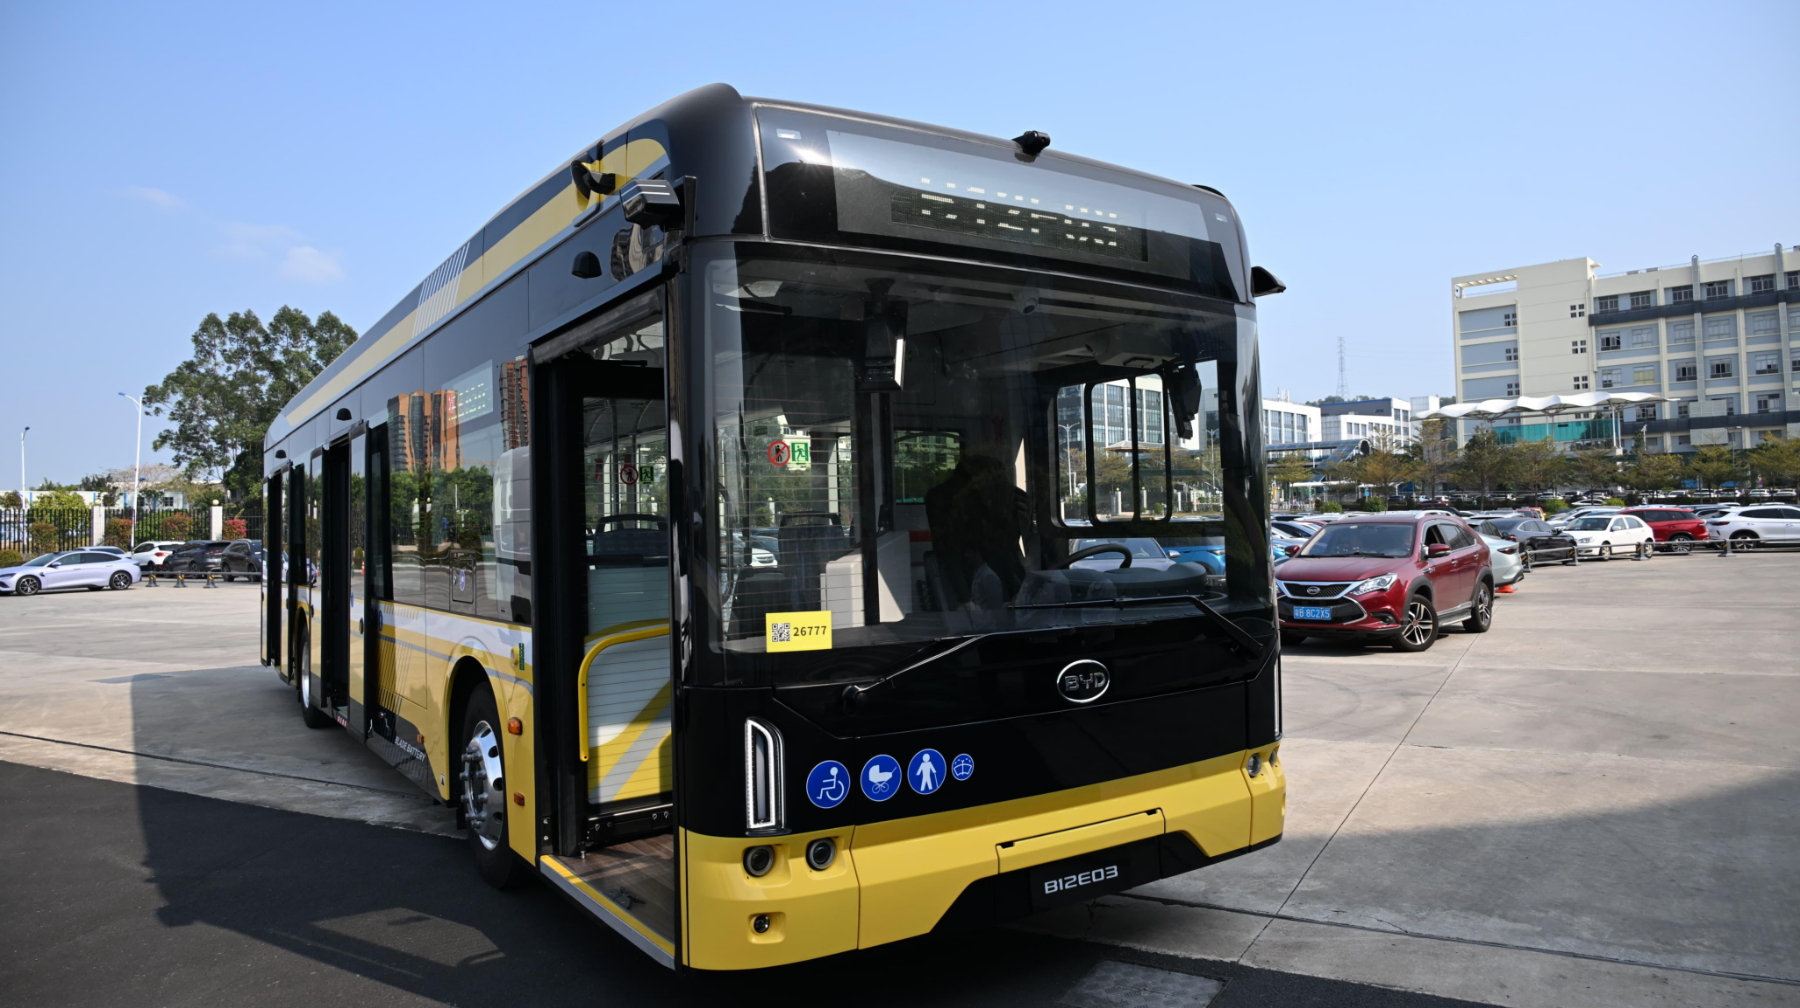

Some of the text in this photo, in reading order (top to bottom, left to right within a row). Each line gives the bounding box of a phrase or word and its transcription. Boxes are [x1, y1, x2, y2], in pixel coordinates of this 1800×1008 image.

[1306, 609, 1330, 618] 8C2X5
[793, 625, 827, 637] 26777
[1064, 671, 1106, 692] BYD
[406, 743, 426, 762] BATTERY
[1044, 864, 1119, 895] B12E03
